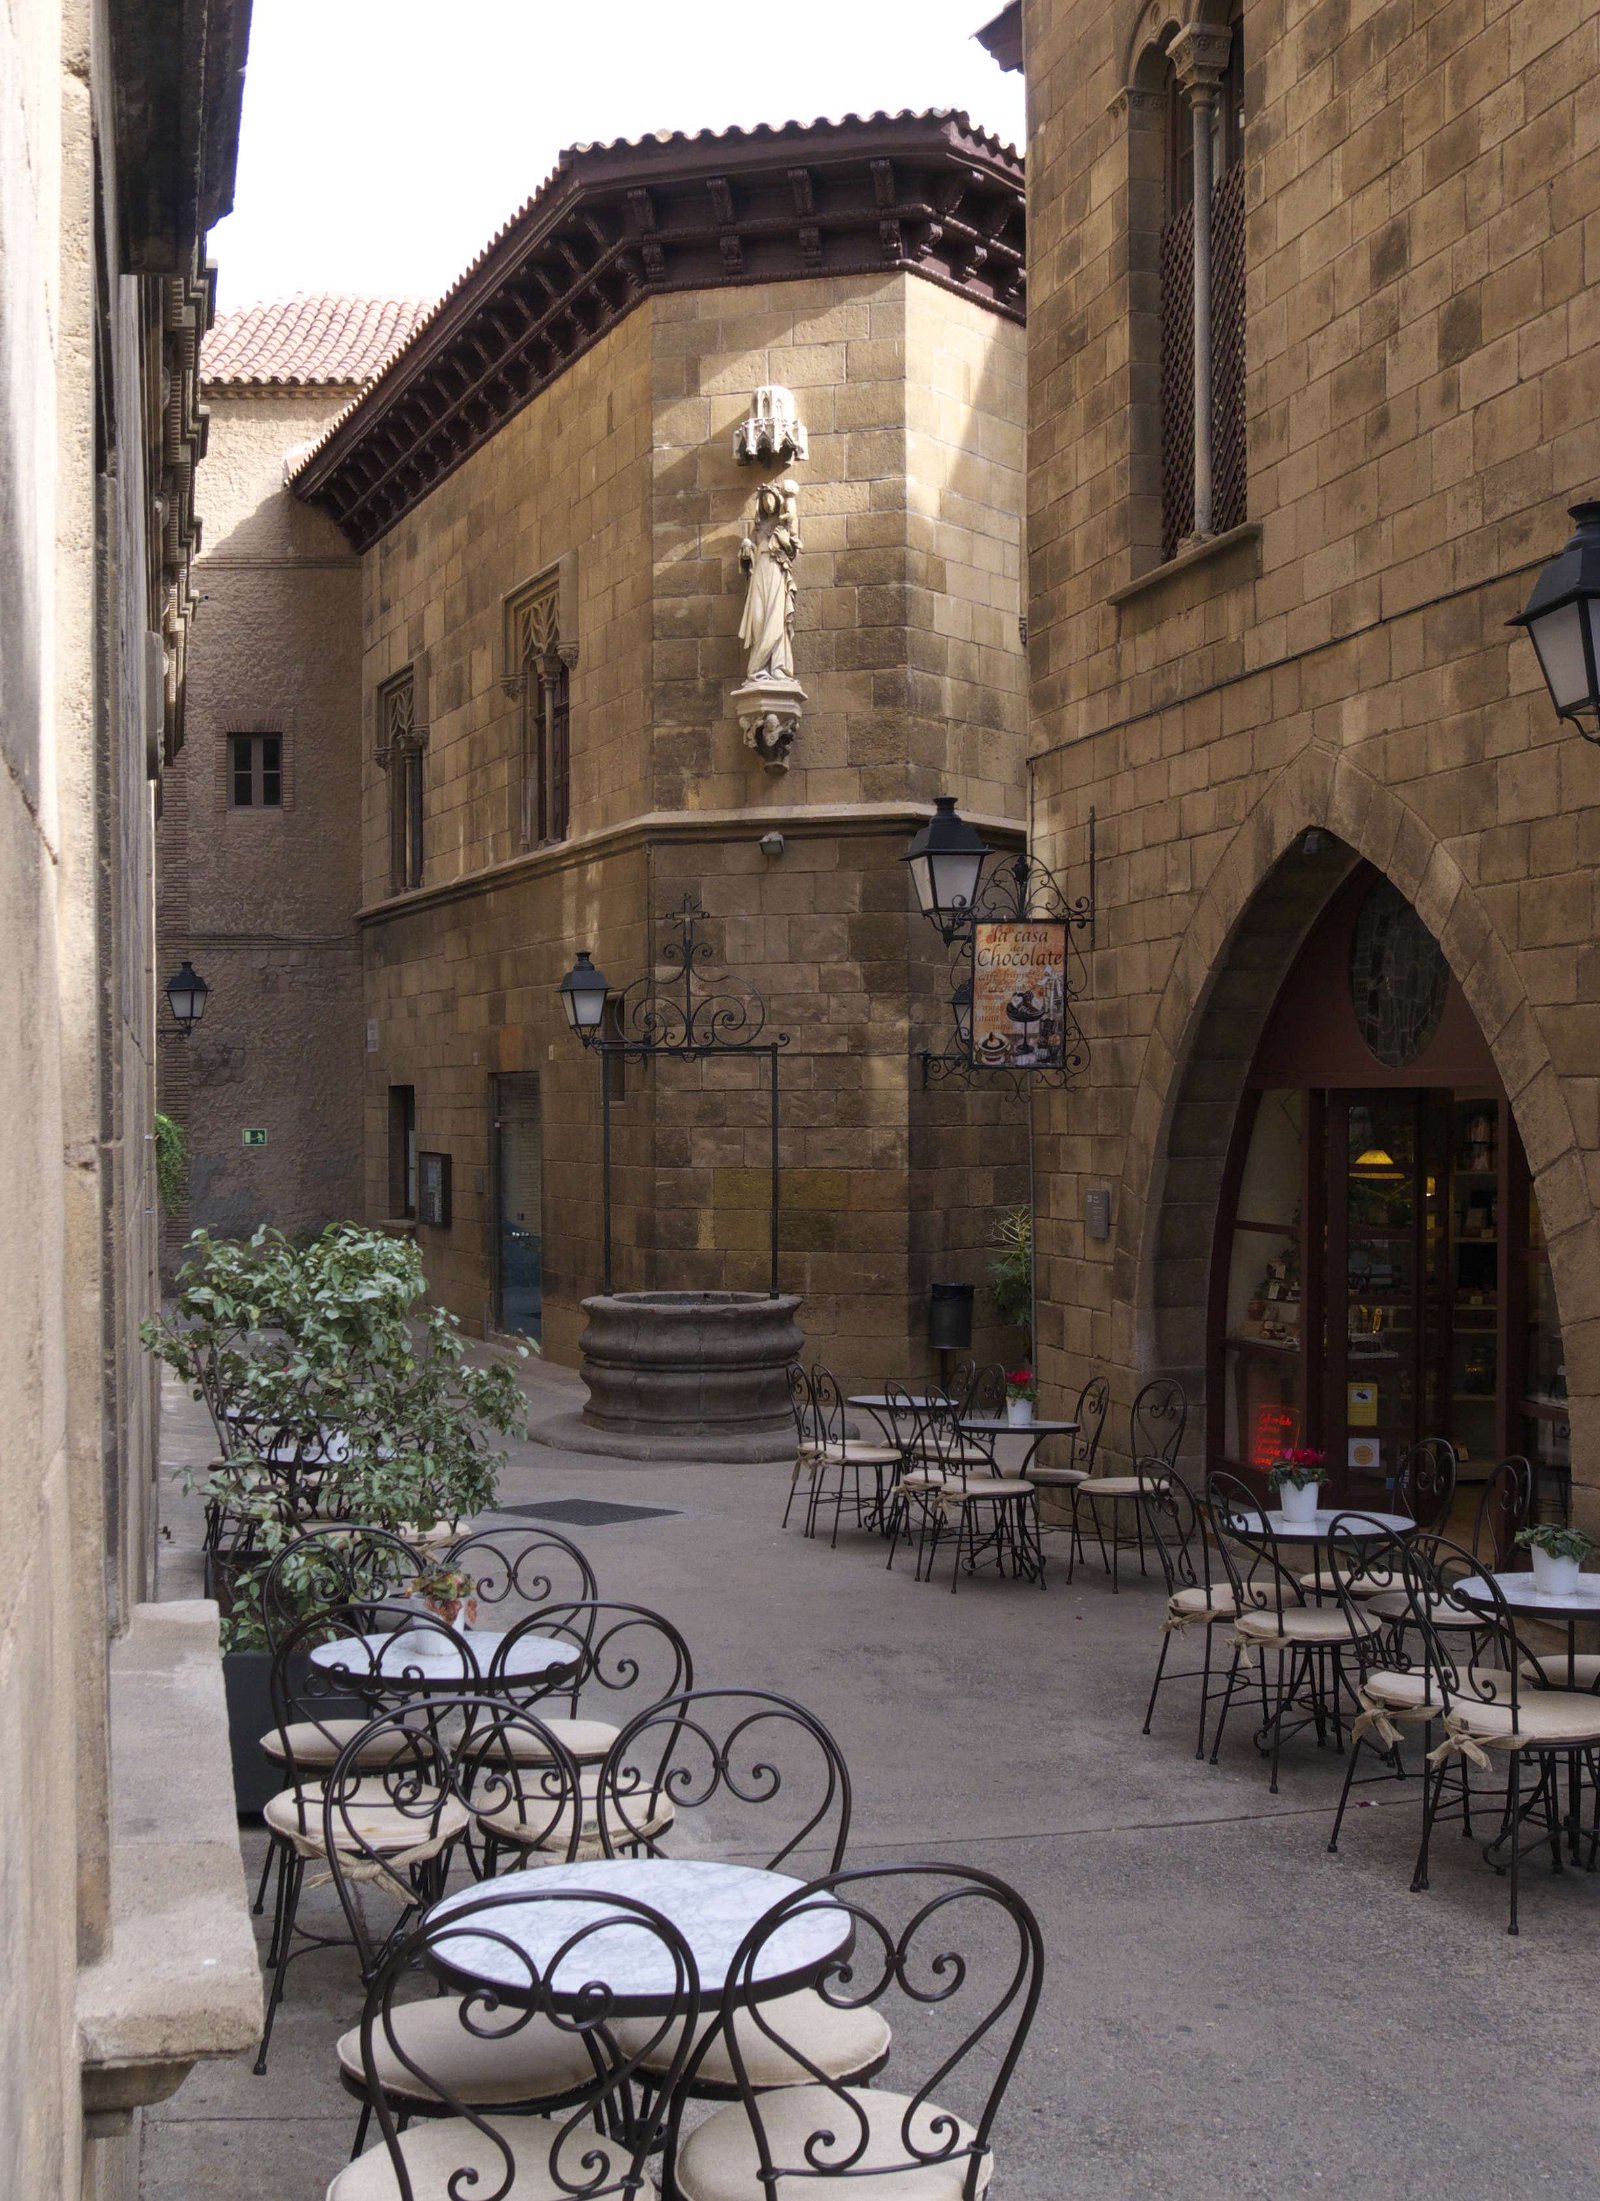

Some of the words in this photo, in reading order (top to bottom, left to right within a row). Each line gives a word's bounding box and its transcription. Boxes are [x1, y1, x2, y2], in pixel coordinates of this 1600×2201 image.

[1014, 930, 1048, 942] casa
[1010, 944, 1024, 952] del
[977, 943, 1062, 967] Chocolate
